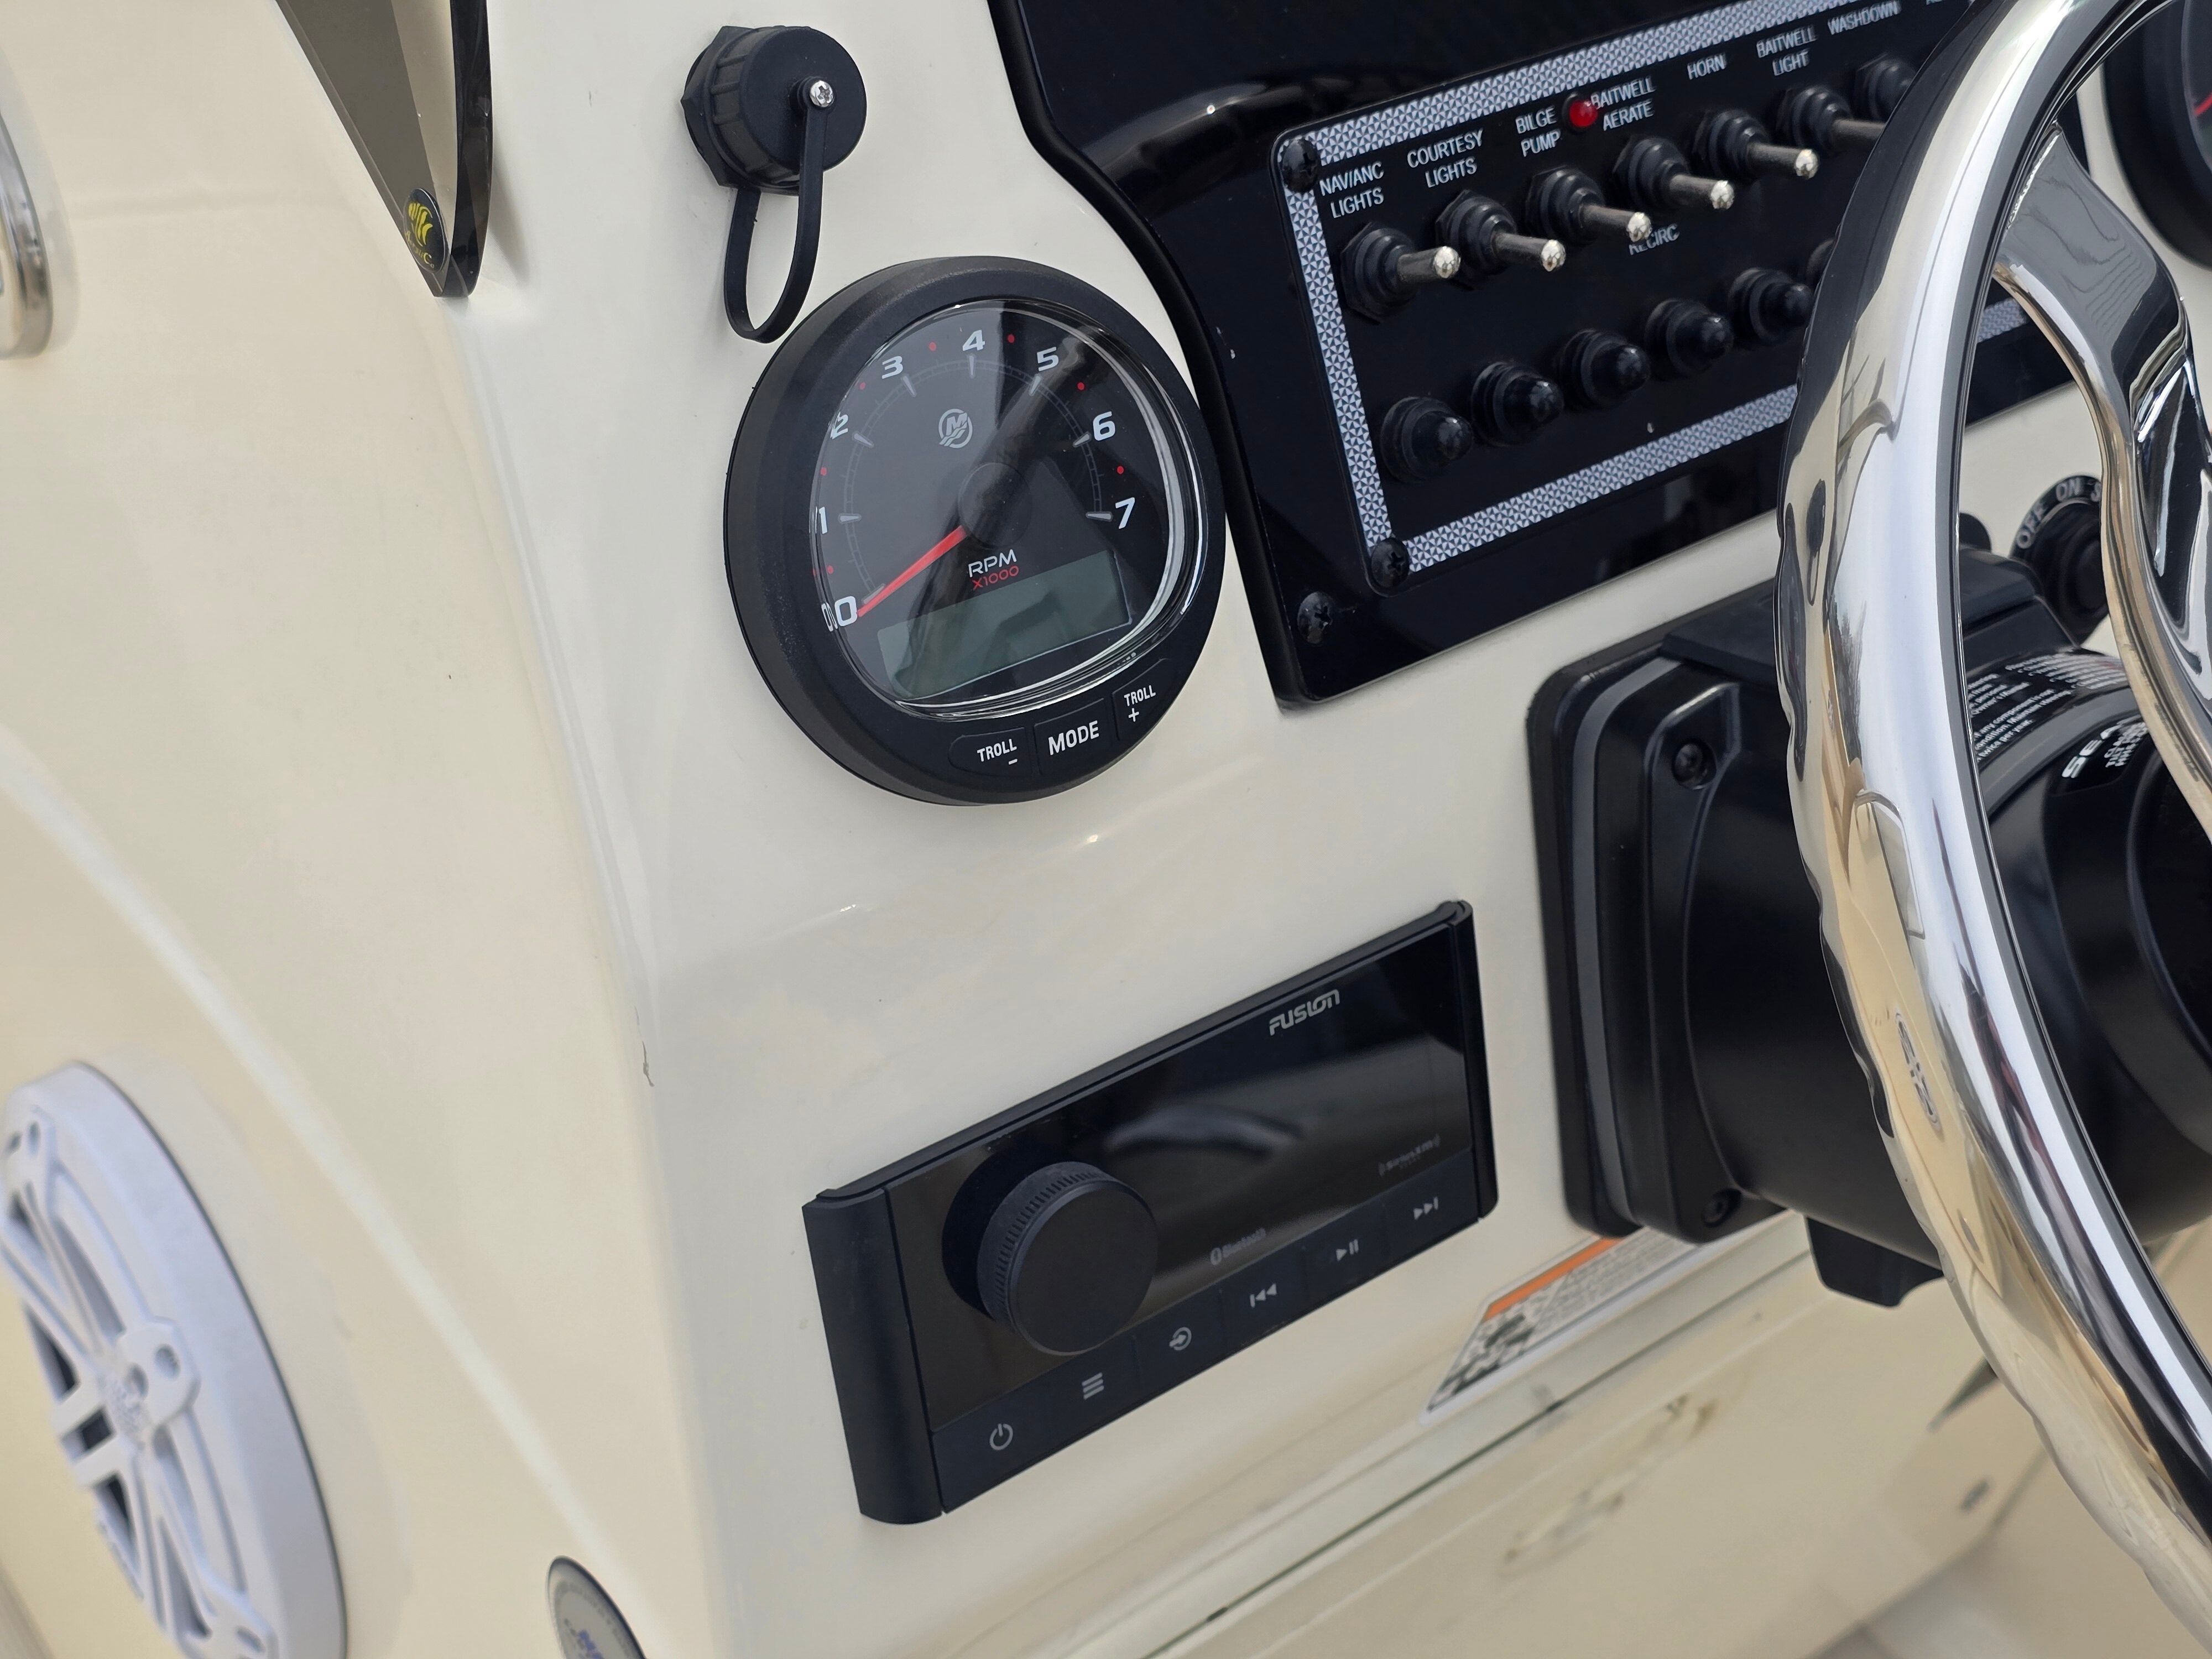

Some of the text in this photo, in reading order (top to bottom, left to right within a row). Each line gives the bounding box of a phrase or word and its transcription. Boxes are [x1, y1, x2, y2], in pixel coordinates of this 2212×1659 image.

[1828, 1, 1902, 35] WASHDOWN
[1756, 24, 1818, 58] BAITWELL
[1688, 54, 1726, 80] HORN
[1772, 49, 1809, 76] LIGHT
[1590, 76, 1655, 109] BAITWELL
[1515, 105, 1557, 134] BILGE
[1603, 99, 1655, 131] AERATE
[1407, 128, 1484, 168] COURTESY
[1521, 128, 1561, 157] PUMP
[1425, 156, 1478, 188] LIGHTS
[1331, 187, 1384, 218] LIGHTS
[962, 330, 985, 351] 4
[881, 355, 904, 379] 3
[1037, 347, 1059, 371] 5
[831, 411, 849, 440] 2
[1093, 411, 1116, 441] 6
[2056, 477, 2083, 502] ON
[818, 507, 828, 534] 1
[1115, 497, 1136, 529] 7
[968, 549, 1017, 578] RPM
[972, 565, 1019, 591] X1000
[834, 596, 858, 627] 0
[1124, 685, 1156, 706] TROLL
[977, 739, 1017, 762] TROLL
[1048, 720, 1099, 756] MODE
[1269, 989, 1340, 1036] FUSION
